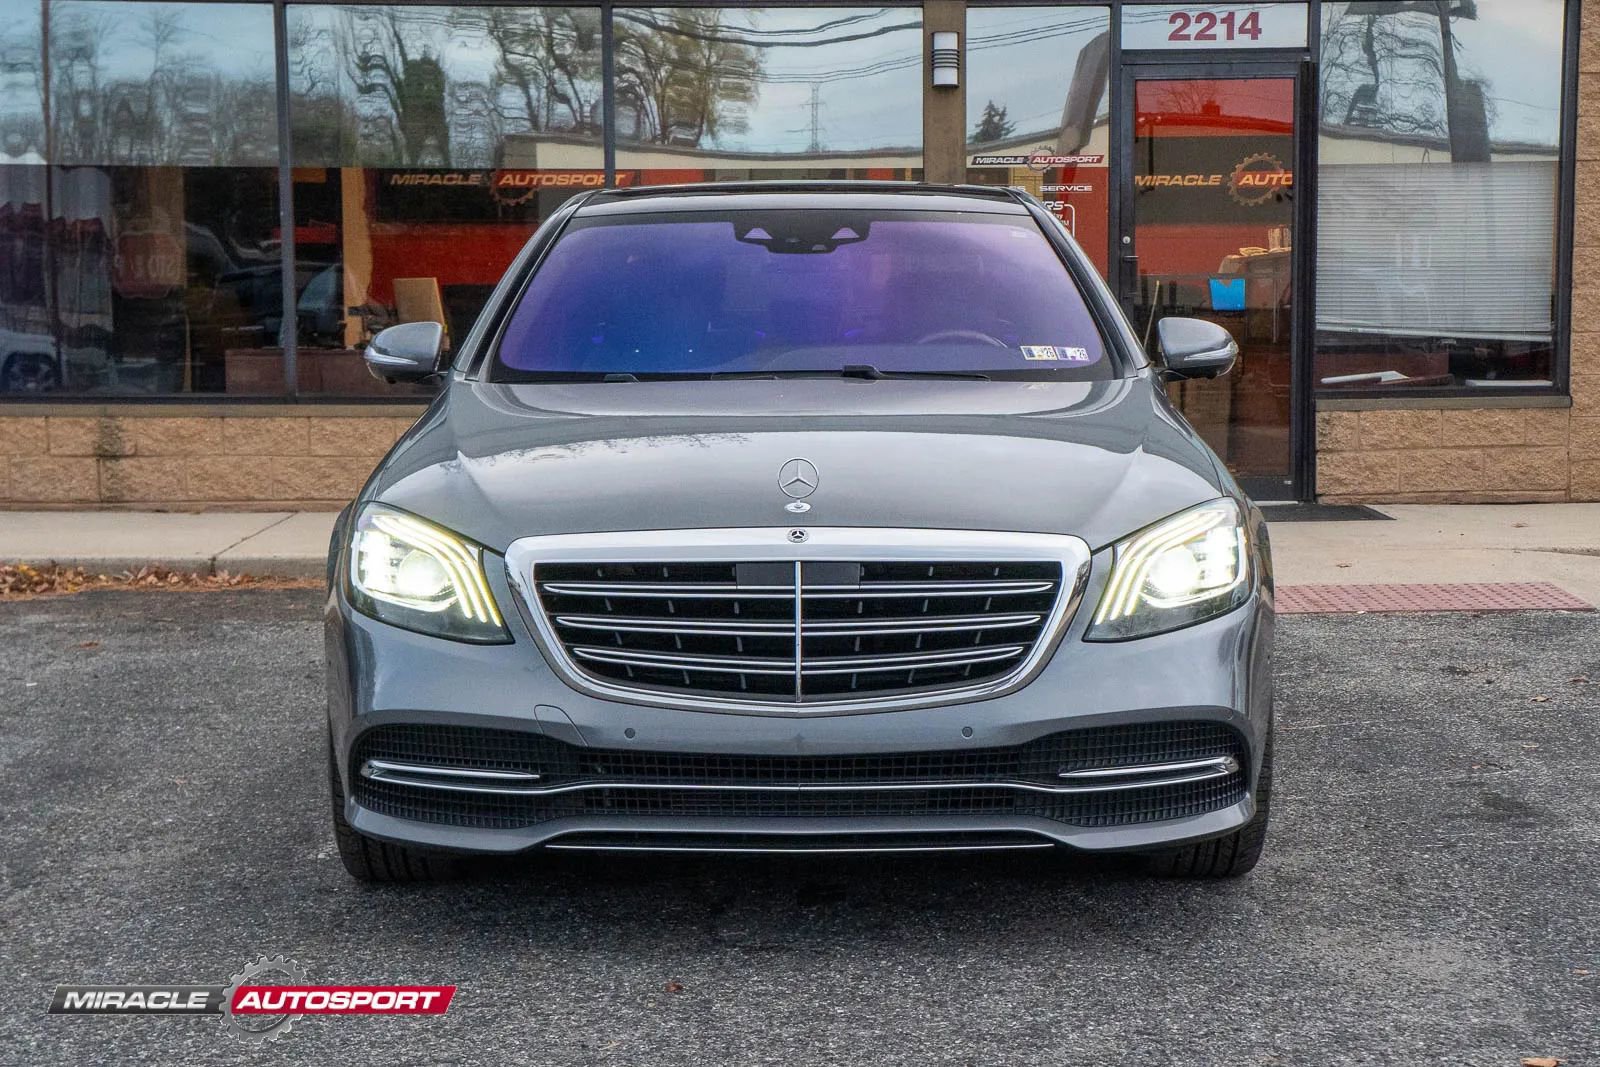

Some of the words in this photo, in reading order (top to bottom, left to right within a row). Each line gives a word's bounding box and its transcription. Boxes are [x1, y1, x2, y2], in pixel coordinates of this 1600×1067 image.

[1167, 11, 1263, 42] 2214
[974, 156, 1025, 165] MIRACLE
[1032, 155, 1101, 164] AUTOSPORT
[390, 172, 483, 186] MIRACLE
[1134, 174, 1223, 187] MIRACLE
[1039, 184, 1093, 192] SERVICE
